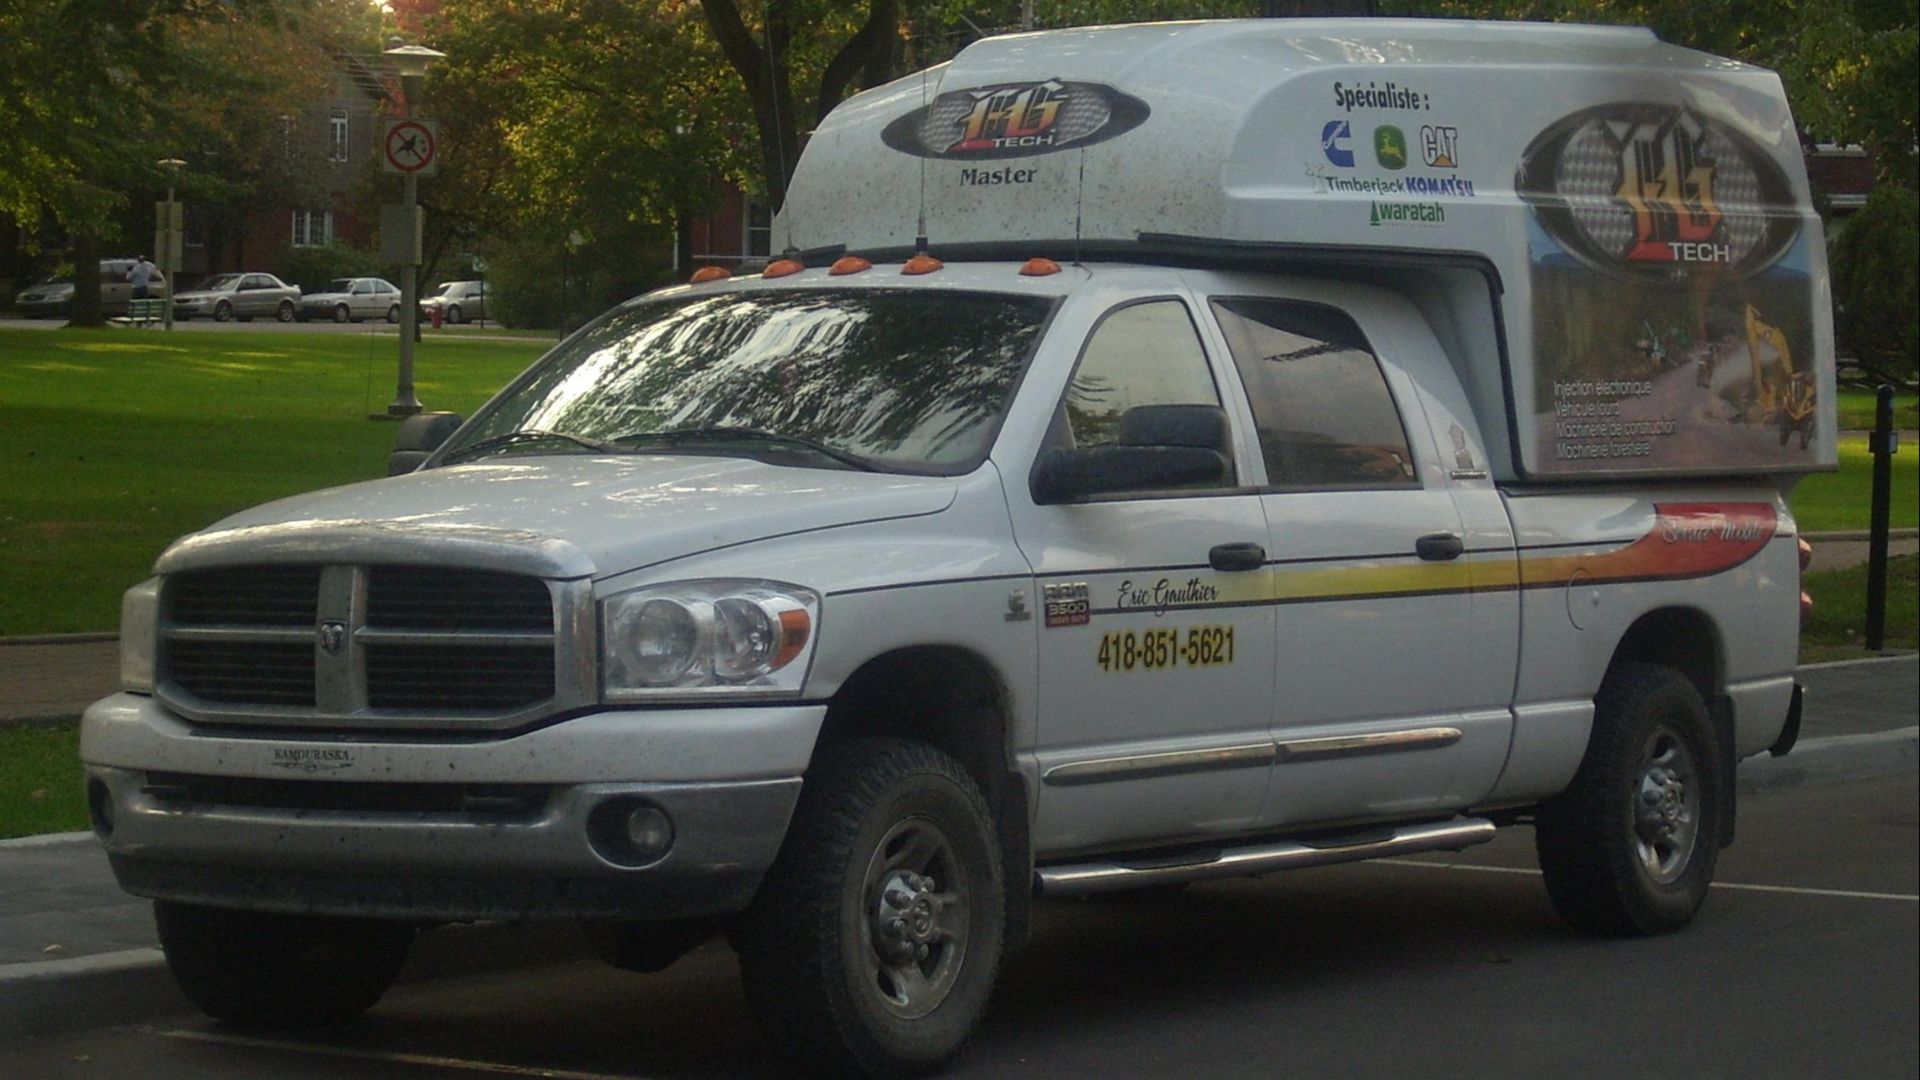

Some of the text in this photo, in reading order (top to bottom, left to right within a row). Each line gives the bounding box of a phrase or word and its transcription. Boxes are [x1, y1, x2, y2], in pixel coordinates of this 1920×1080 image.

[991, 134, 1054, 149] TECH
[1420, 125, 1458, 168] CAT
[959, 168, 1037, 187] Master
[1326, 176, 1404, 196] Timberjack
[1405, 174, 1475, 197] KOMATSU
[1379, 201, 1445, 223] waratah
[1669, 242, 1730, 263] TECH
[1118, 577, 1219, 617] Eric Gauthier
[1050, 602, 1087, 615] 3500
[274, 749, 350, 761] KAMOURASKA
